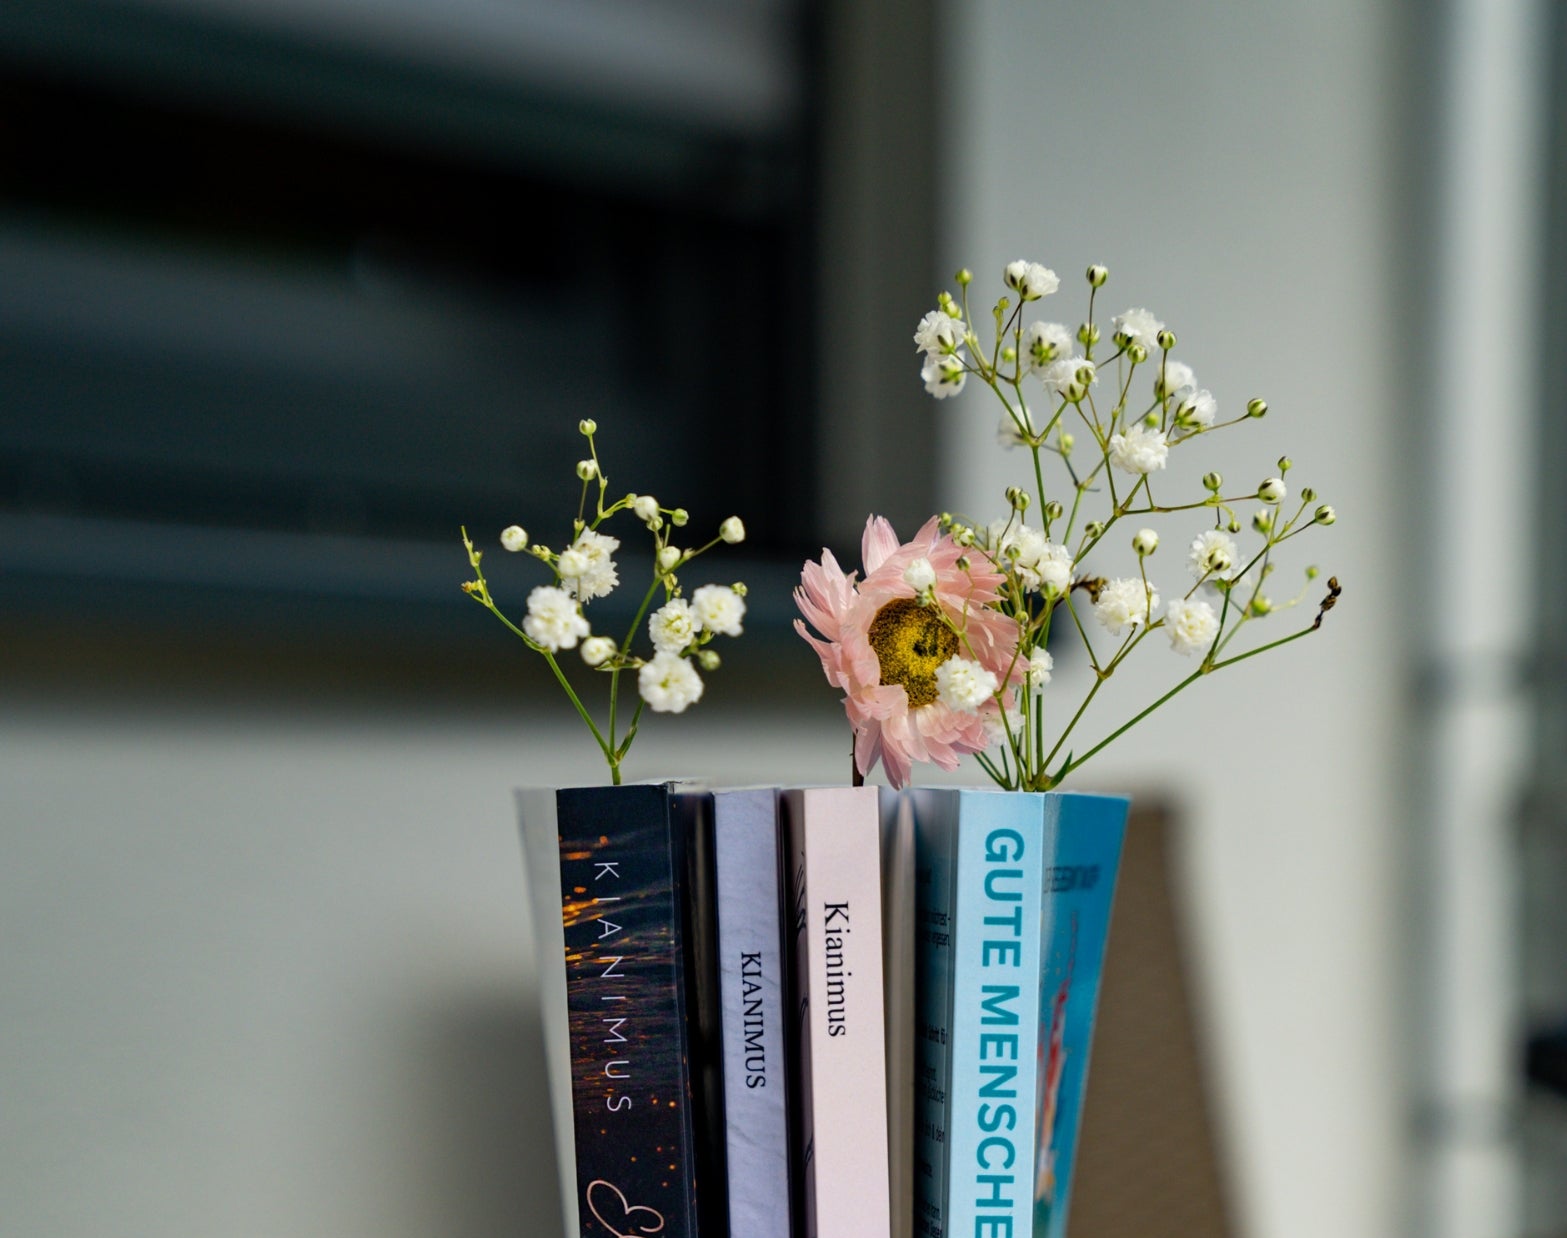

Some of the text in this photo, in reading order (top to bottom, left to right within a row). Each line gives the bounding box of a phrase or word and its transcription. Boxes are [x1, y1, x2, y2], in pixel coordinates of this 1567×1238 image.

[981, 828, 1026, 968] GUTE
[592, 861, 632, 1113] KIANIMUS
[740, 951, 767, 1089] KIANIMUS
[824, 900, 850, 1038] Kianimus
